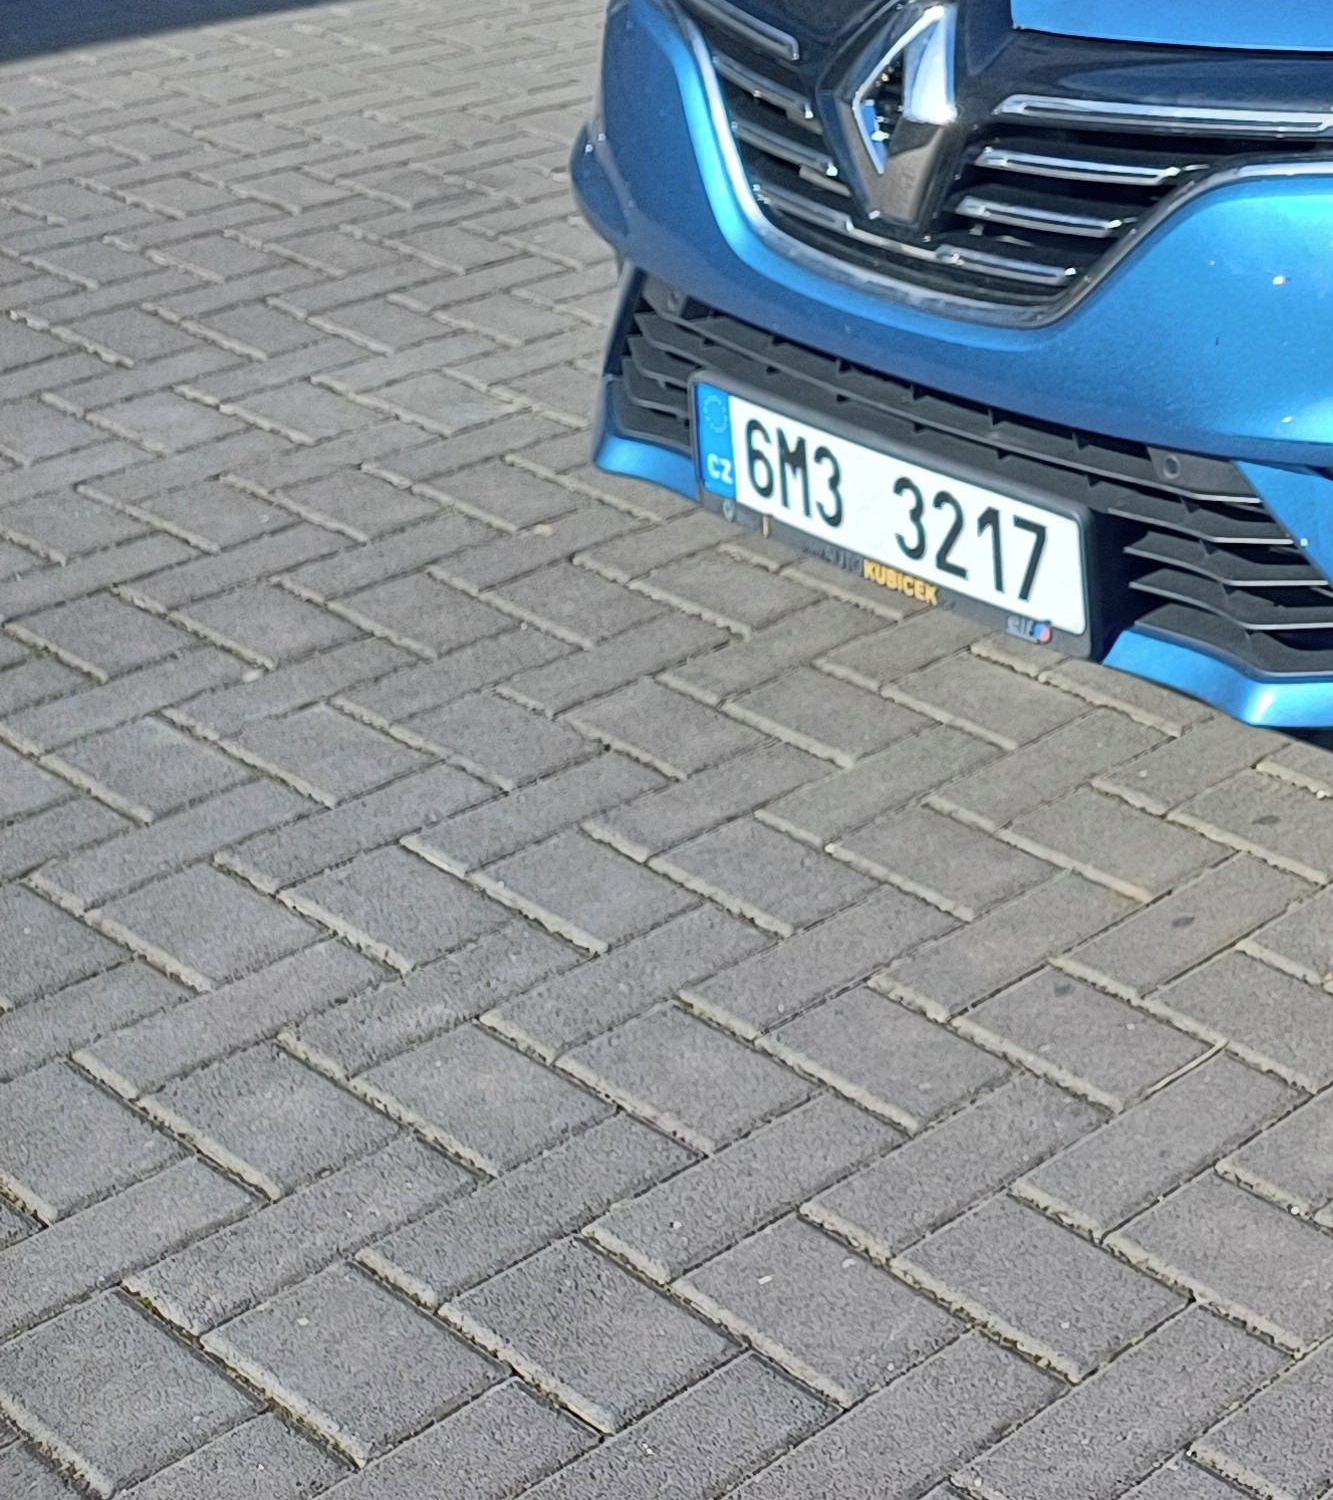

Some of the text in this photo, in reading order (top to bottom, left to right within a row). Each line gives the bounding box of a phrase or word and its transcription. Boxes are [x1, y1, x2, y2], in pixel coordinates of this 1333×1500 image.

[707, 452, 734, 485] CZ
[745, 418, 1048, 602] 6M3 3217
